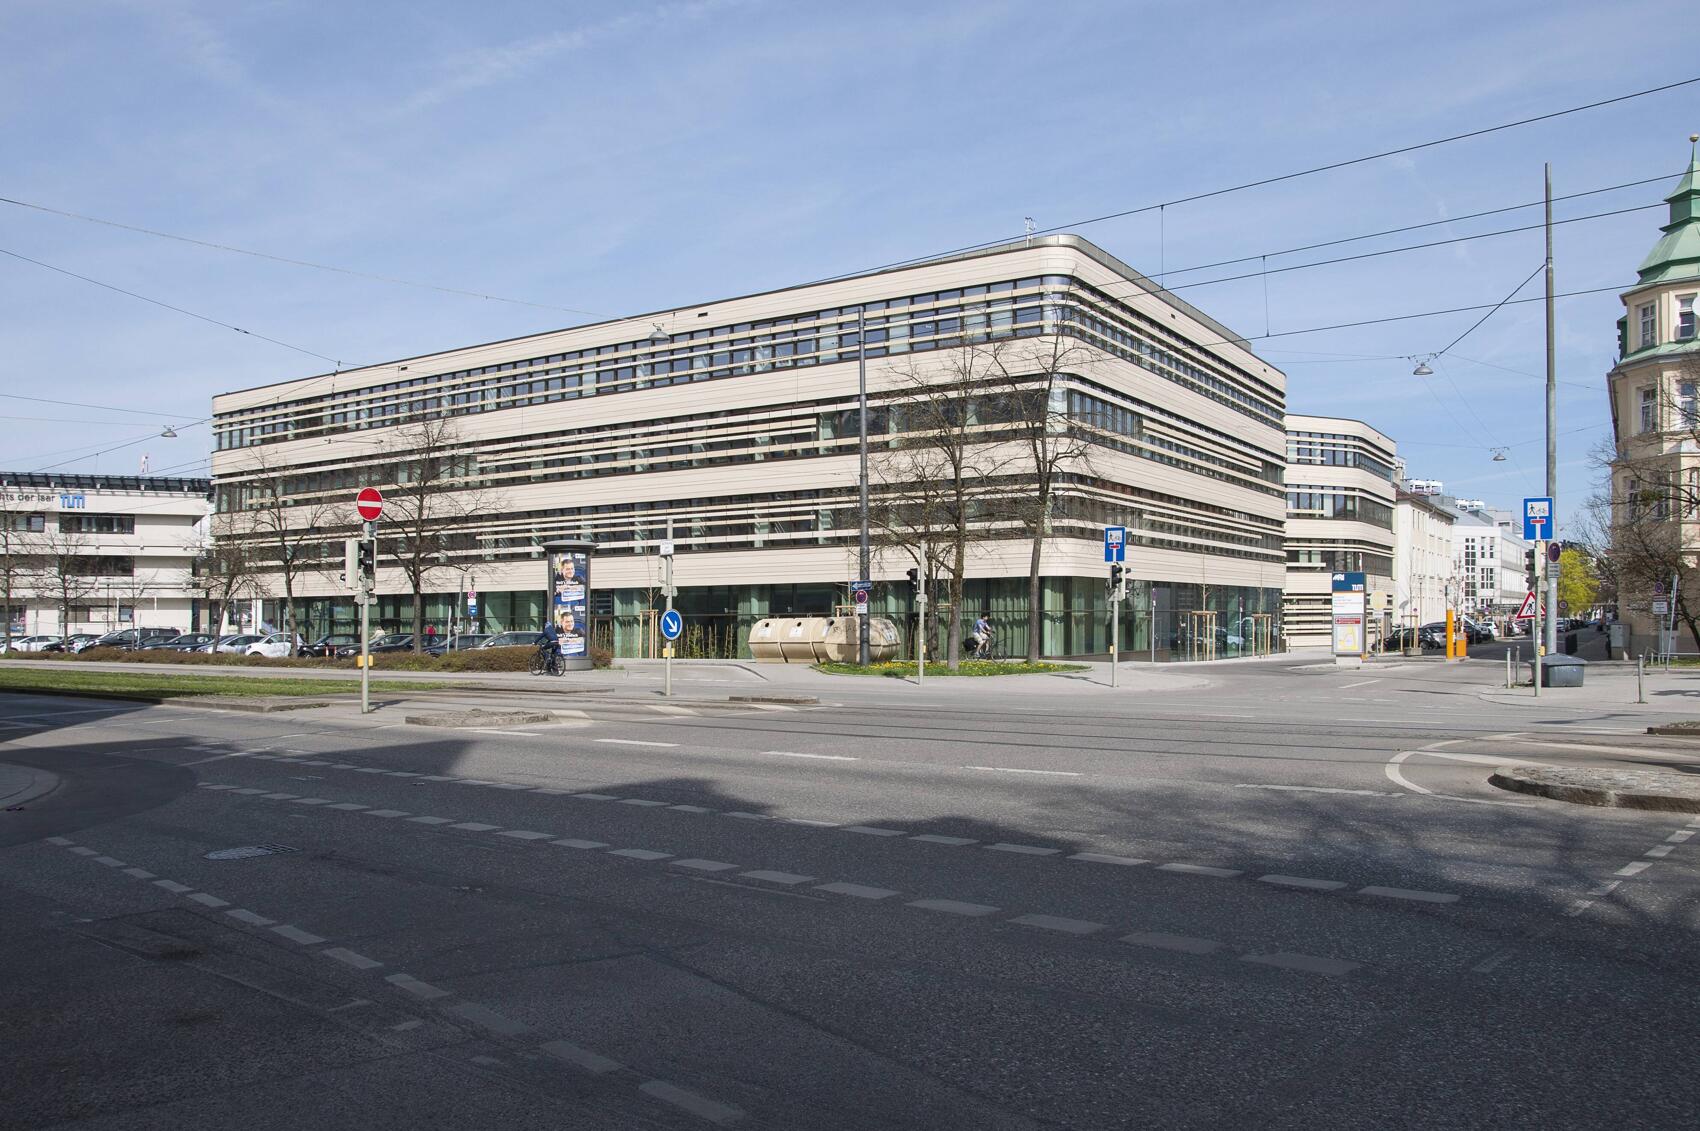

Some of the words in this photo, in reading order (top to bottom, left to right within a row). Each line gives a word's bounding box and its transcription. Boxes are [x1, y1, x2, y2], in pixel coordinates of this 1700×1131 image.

[18, 493, 35, 501] der
[38, 493, 55, 502] Isar
[61, 495, 85, 508] TUM
